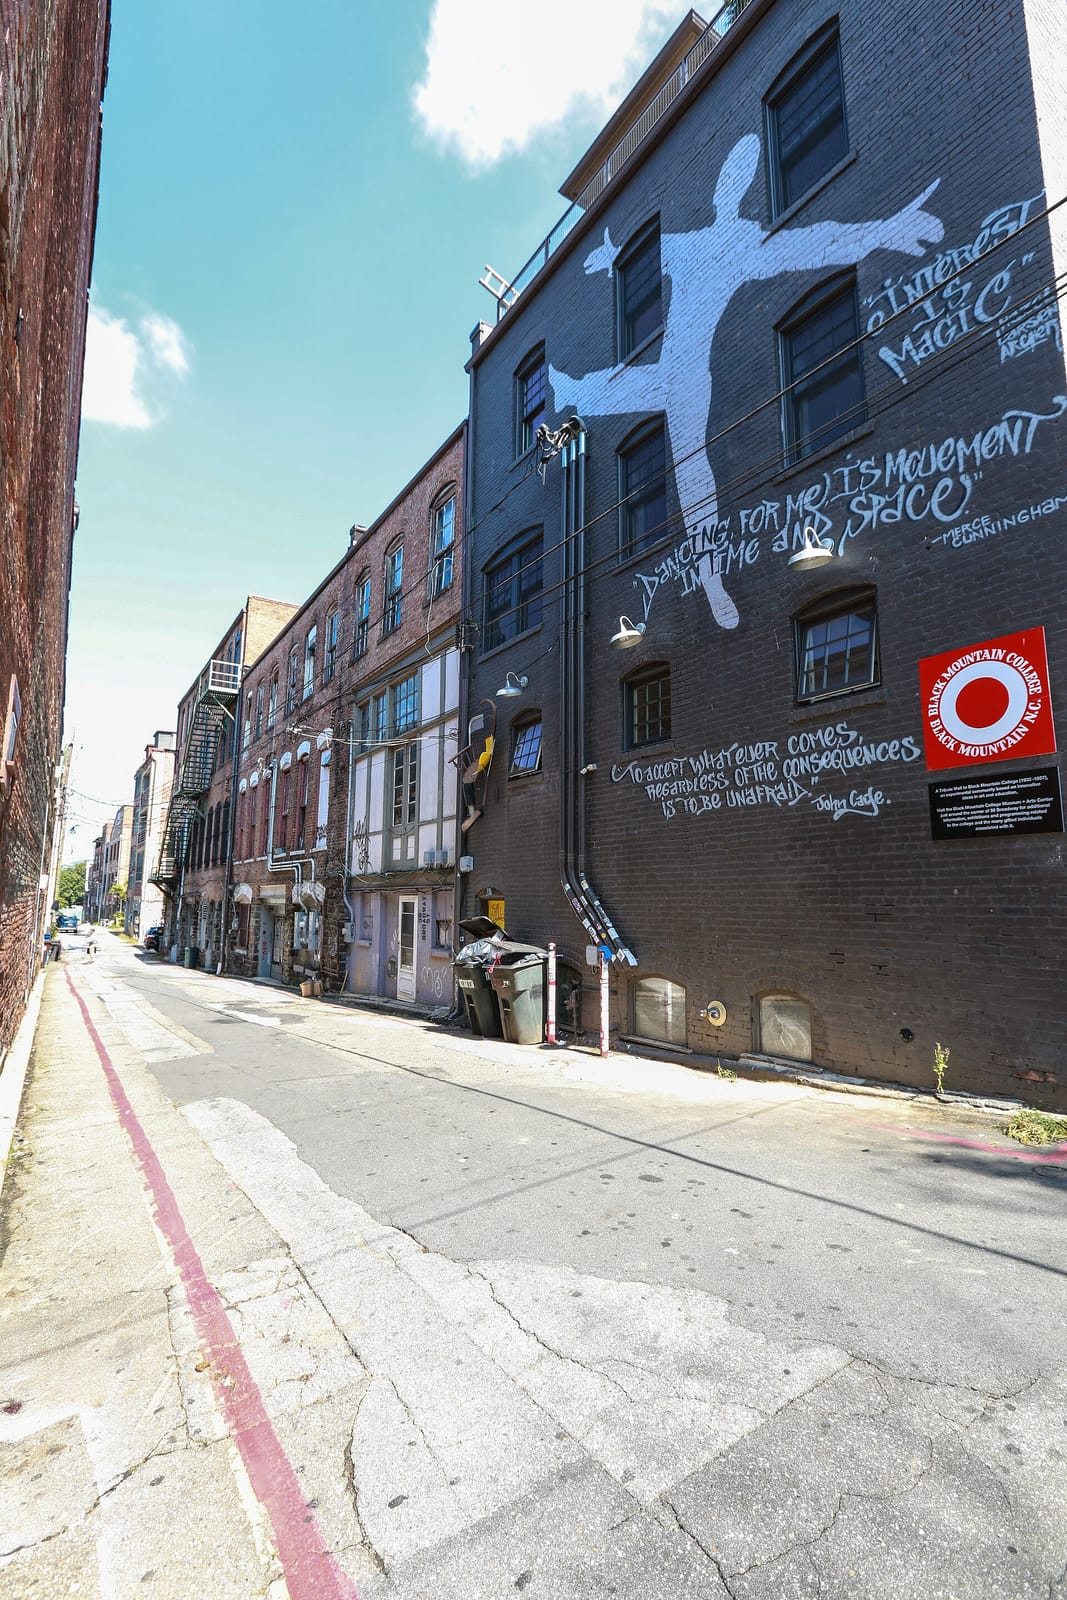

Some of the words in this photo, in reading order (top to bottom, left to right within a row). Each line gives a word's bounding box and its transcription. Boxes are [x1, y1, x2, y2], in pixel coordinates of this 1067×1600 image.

[739, 500, 781, 535] FOR
[831, 453, 881, 502] IS
[674, 566, 707, 597] IN
[928, 679, 946, 717] BLACK
[942, 648, 1006, 679] MOUNTAIN
[1006, 652, 1042, 695] COLLEGE
[930, 719, 957, 751] BLACK
[957, 723, 1029, 757] MOUNTAIN
[1025, 698, 1042, 724] N.C.
[734, 766, 750, 787] OF
[675, 797, 697, 814] TO
